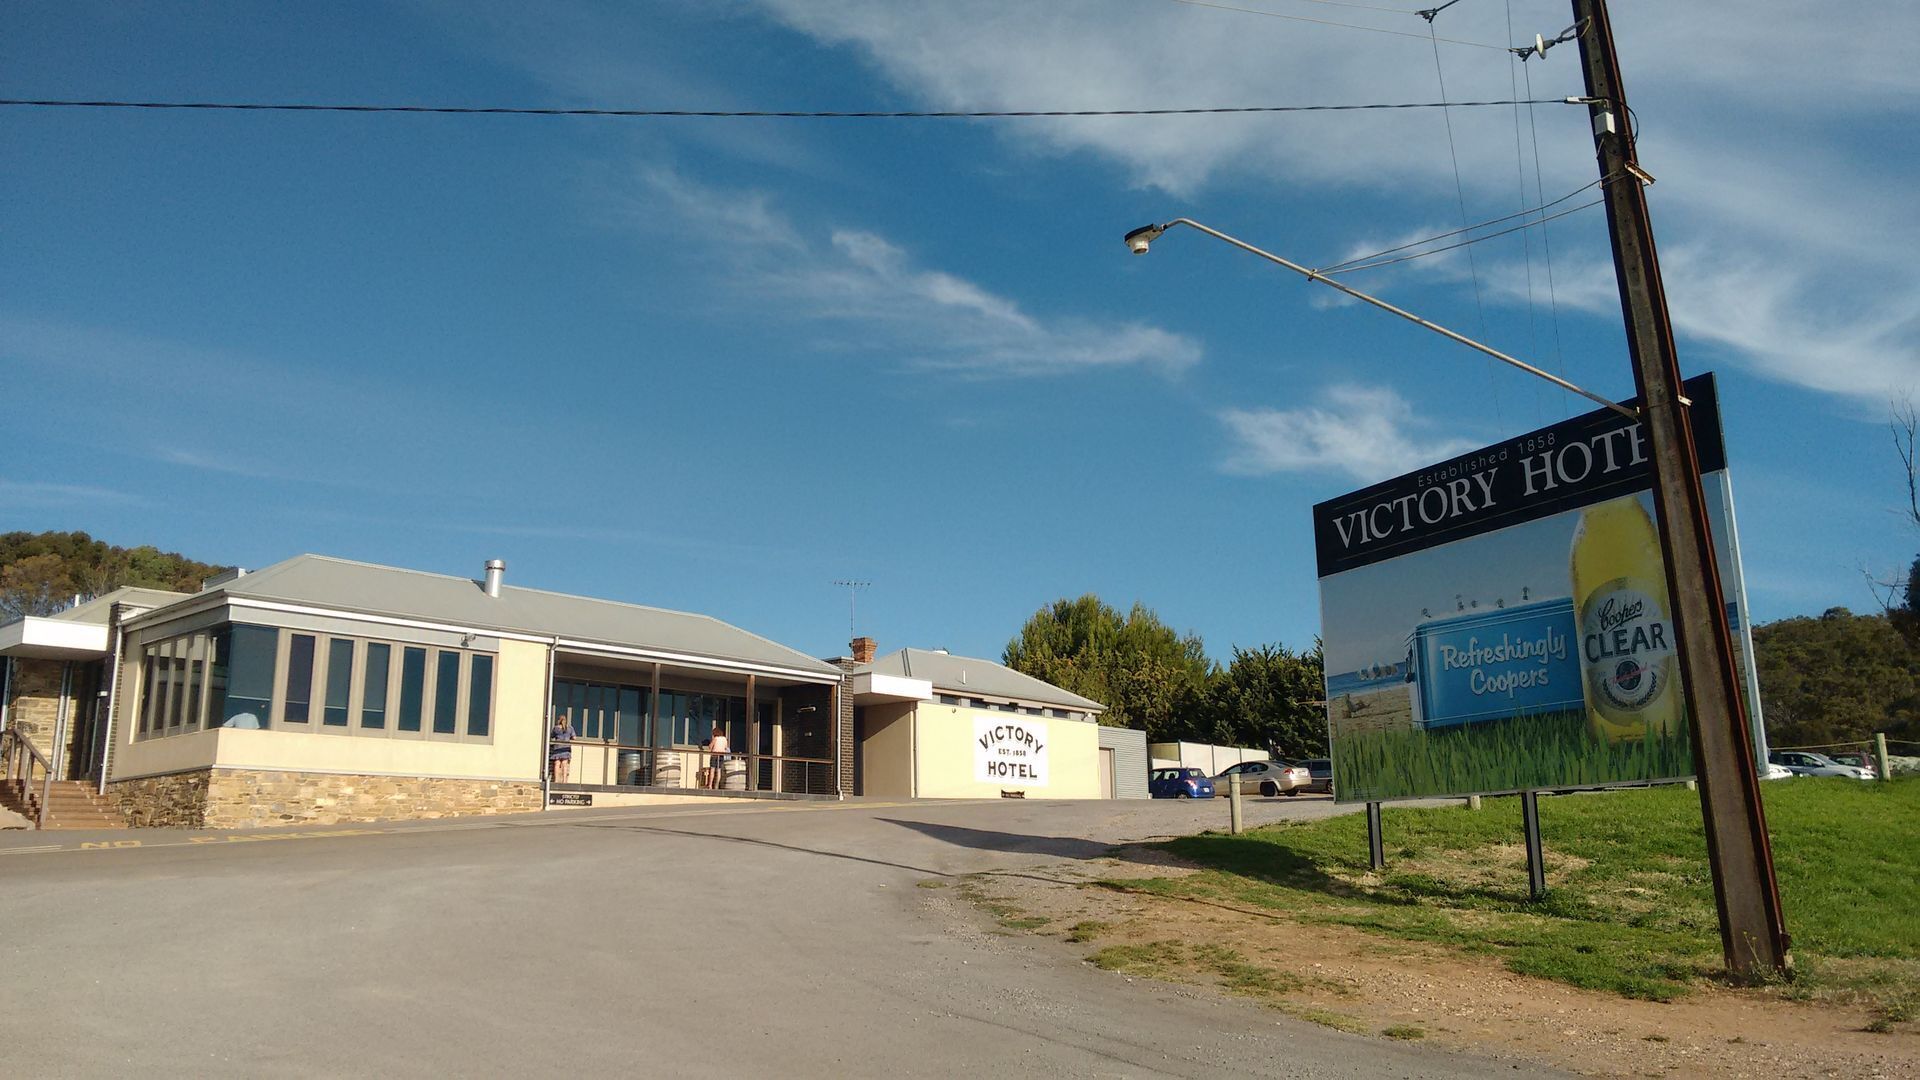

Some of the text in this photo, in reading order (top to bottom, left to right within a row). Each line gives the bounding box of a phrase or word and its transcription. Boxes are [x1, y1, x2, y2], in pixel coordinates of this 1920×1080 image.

[1418, 432, 1556, 487] Established 1858
[1332, 422, 1648, 549] VICTORY HOTE
[1440, 626, 1567, 671] Refreshingly
[1585, 623, 1668, 663] CLEAR
[1470, 668, 1549, 698] Coopers
[979, 725, 1044, 754] VICTORY
[988, 761, 1038, 778] HOTEL
